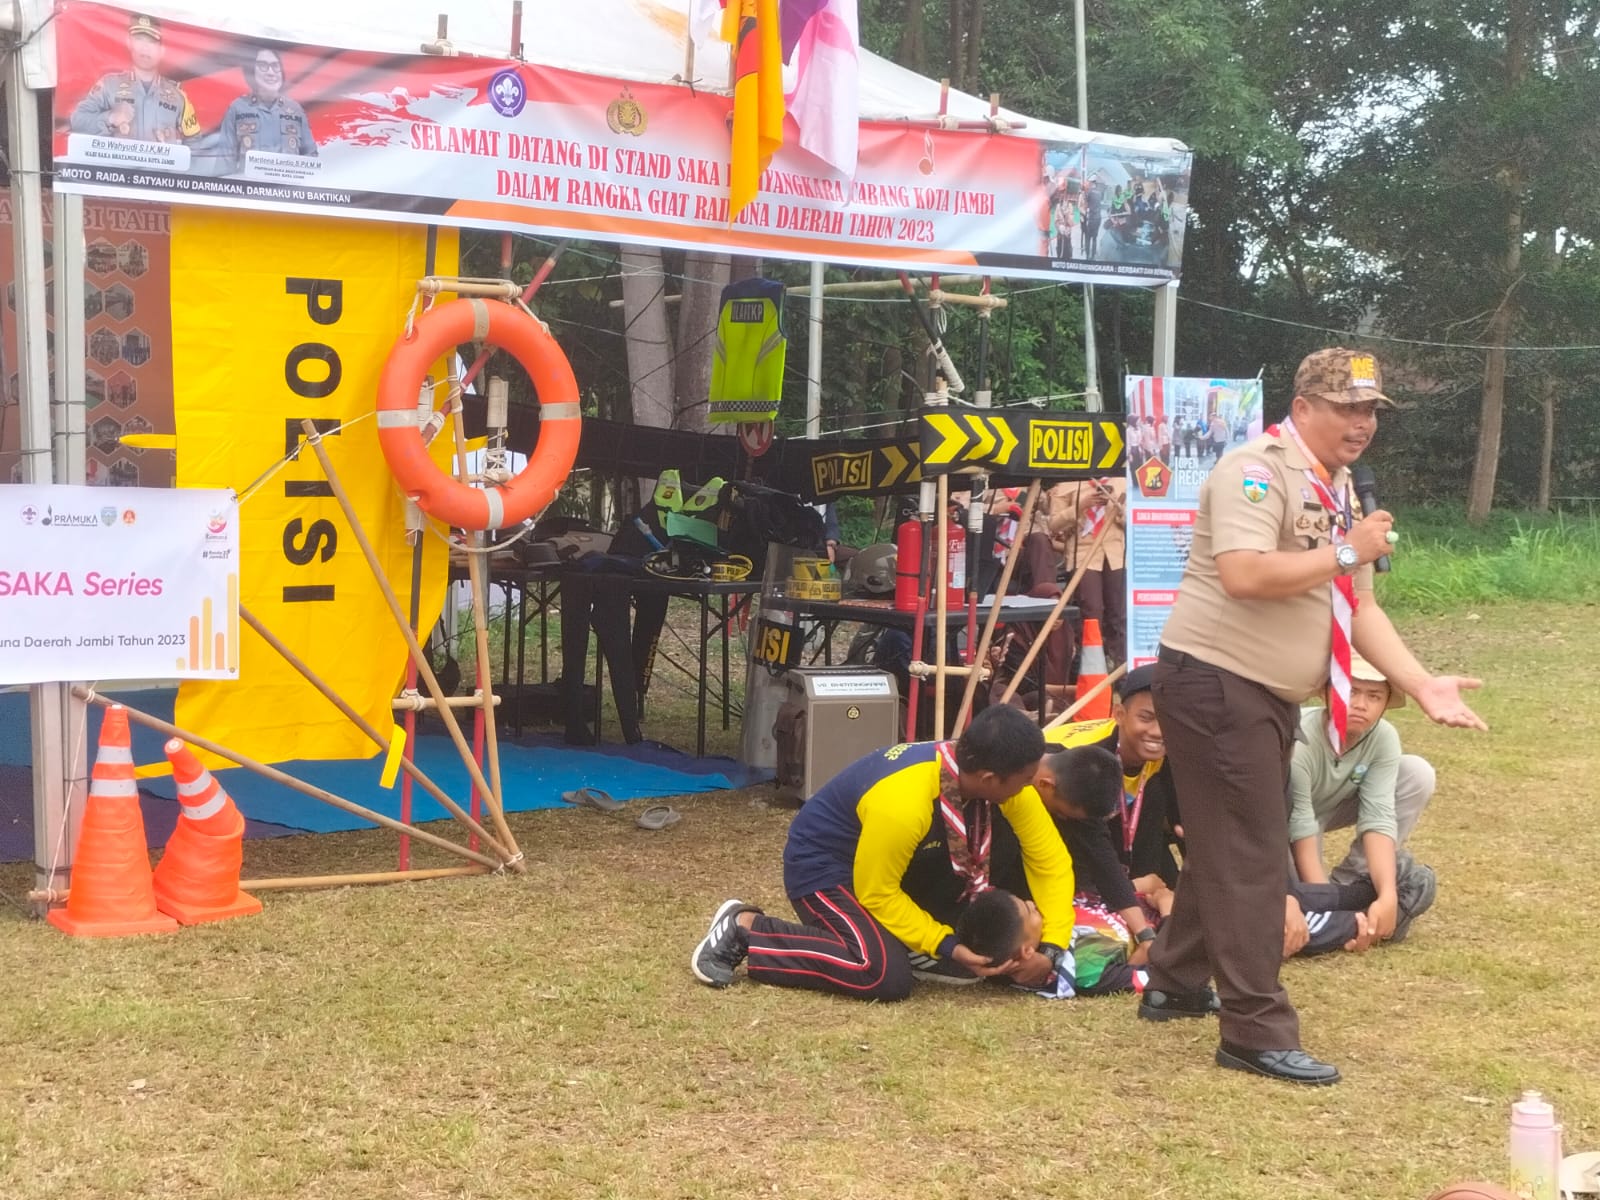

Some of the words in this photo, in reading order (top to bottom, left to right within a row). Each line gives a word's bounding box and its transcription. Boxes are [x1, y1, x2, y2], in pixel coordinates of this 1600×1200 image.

[62, 168, 92, 180] MOTO
[96, 172, 126, 183] RAIDA
[133, 175, 175, 187] SATYAKU
[176, 179, 190, 189] KU
[191, 181, 245, 196] DARMAKAN,
[246, 186, 291, 198] DARMAKU
[292, 190, 305, 200] KU
[307, 191, 351, 204] BAKTIKAN
[410, 123, 500, 157] SELAMAT
[508, 133, 582, 168] DATANG
[589, 144, 608, 171] DI
[615, 148, 671, 180] STAND
[678, 156, 720, 187] SAKA
[913, 186, 949, 213] KOTA
[953, 190, 996, 216] JAMBI
[497, 169, 560, 202] DALAM
[567, 179, 642, 212] RANGKA
[648, 189, 690, 218] GIAT
[776, 205, 844, 235] DAERAH
[849, 212, 896, 239] TAHUN
[897, 218, 935, 243] 2023
[283, 277, 342, 602] POLISI
[1034, 427, 1089, 461] POLISI
[816, 456, 869, 489] POLISI
[1179, 457, 1199, 470] OPEN
[54, 514, 98, 523] PRAMUKA
[0, 571, 74, 597] SAKA
[83, 571, 164, 597] Series
[24, 636, 72, 648] Daerah
[76, 635, 114, 647] Jambi
[117, 635, 154, 646] Tahun
[157, 634, 186, 646] 2023
